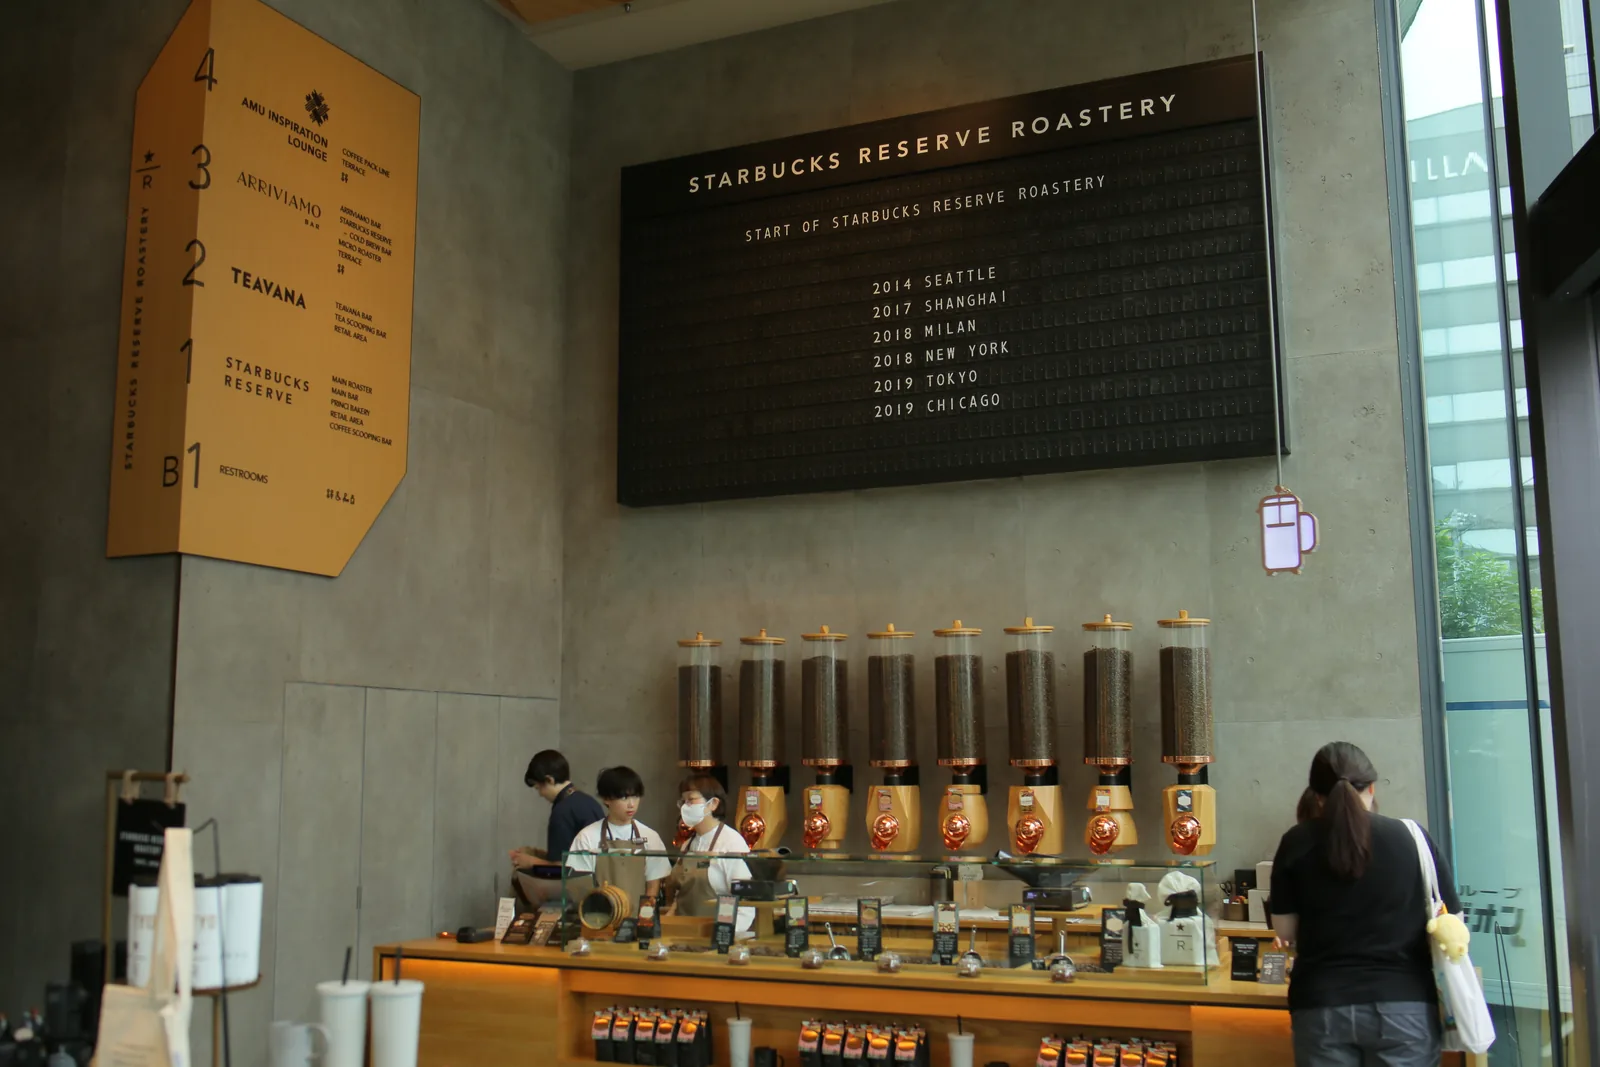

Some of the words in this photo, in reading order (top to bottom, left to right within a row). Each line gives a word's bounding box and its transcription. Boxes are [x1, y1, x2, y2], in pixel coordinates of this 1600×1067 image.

[194, 48, 218, 92] 4
[242, 98, 266, 116] AMU
[268, 110, 328, 148] INSPIRATION
[288, 135, 328, 162] LOUNGE
[689, 152, 840, 193] STARBUCKS
[858, 126, 990, 164] RESERVE
[1012, 94, 1176, 138] ROASTERY
[188, 144, 211, 190] 3
[342, 148, 363, 165] COFFEE
[364, 158, 378, 172] PACK
[378, 167, 390, 178] LINE
[342, 159, 366, 176] TERRACE
[236, 171, 322, 219] ARRIVIAMO
[746, 224, 790, 242] START
[802, 219, 820, 233] OF
[832, 204, 920, 229] STARBUCKS
[933, 190, 1005, 213] RESERVE
[1018, 175, 1105, 200] ROASTERY
[304, 219, 320, 230] BAR
[340, 206, 370, 224] ARRIVIAMO
[371, 219, 381, 230] BAR
[340, 216, 370, 235] STARBUCKS
[370, 229, 392, 246] RESERVE
[136, 207, 149, 288] ROASTERY
[338, 238, 357, 252] MICRO
[358, 248, 381, 263] ROASTER
[350, 232, 364, 244] COLD
[366, 239, 380, 252] BREW
[381, 246, 392, 256] BAR
[182, 239, 206, 288] 2
[338, 250, 362, 266] TERRACE
[231, 266, 306, 309] TEAVANA
[873, 278, 911, 295] 2014
[924, 266, 996, 288] SEATTLE
[335, 302, 360, 317] TEAVANA
[362, 312, 372, 322] BAR
[873, 302, 911, 318] 2017
[925, 290, 1006, 312] SHANGHAI
[130, 296, 144, 368] RESERVE
[334, 324, 352, 337] RETAIL
[353, 332, 368, 343] AREA
[335, 313, 346, 323] TEA
[346, 318, 375, 335] SCOOPING
[376, 329, 387, 339] BAR
[873, 328, 912, 343] 2018
[925, 319, 976, 337] MILAN
[180, 338, 192, 384] 1
[874, 352, 912, 368] 2018
[926, 347, 955, 362] NEW
[969, 341, 1009, 357] YORK
[226, 356, 310, 392] STARBUCKS
[332, 376, 347, 386] MAIN
[348, 380, 373, 394] ROASTER
[874, 377, 913, 393] 2019
[927, 370, 977, 387] TOKYO
[224, 374, 293, 405] RESERVE
[331, 387, 346, 398] MAIN
[348, 392, 358, 401] BAR
[330, 410, 348, 422] RETAIL
[349, 416, 364, 426] AREA
[350, 404, 370, 416] BAKERY
[874, 402, 914, 417] 2019
[927, 393, 1000, 412] CHICAGO
[124, 378, 138, 470] STARBUCKS
[329, 422, 351, 434] COFFEE
[352, 428, 380, 443] SCOOPING
[382, 437, 392, 446] BAR
[162, 442, 201, 488] B1
[219, 464, 269, 484] RESTROOMS
[1177, 940, 1186, 950] R
